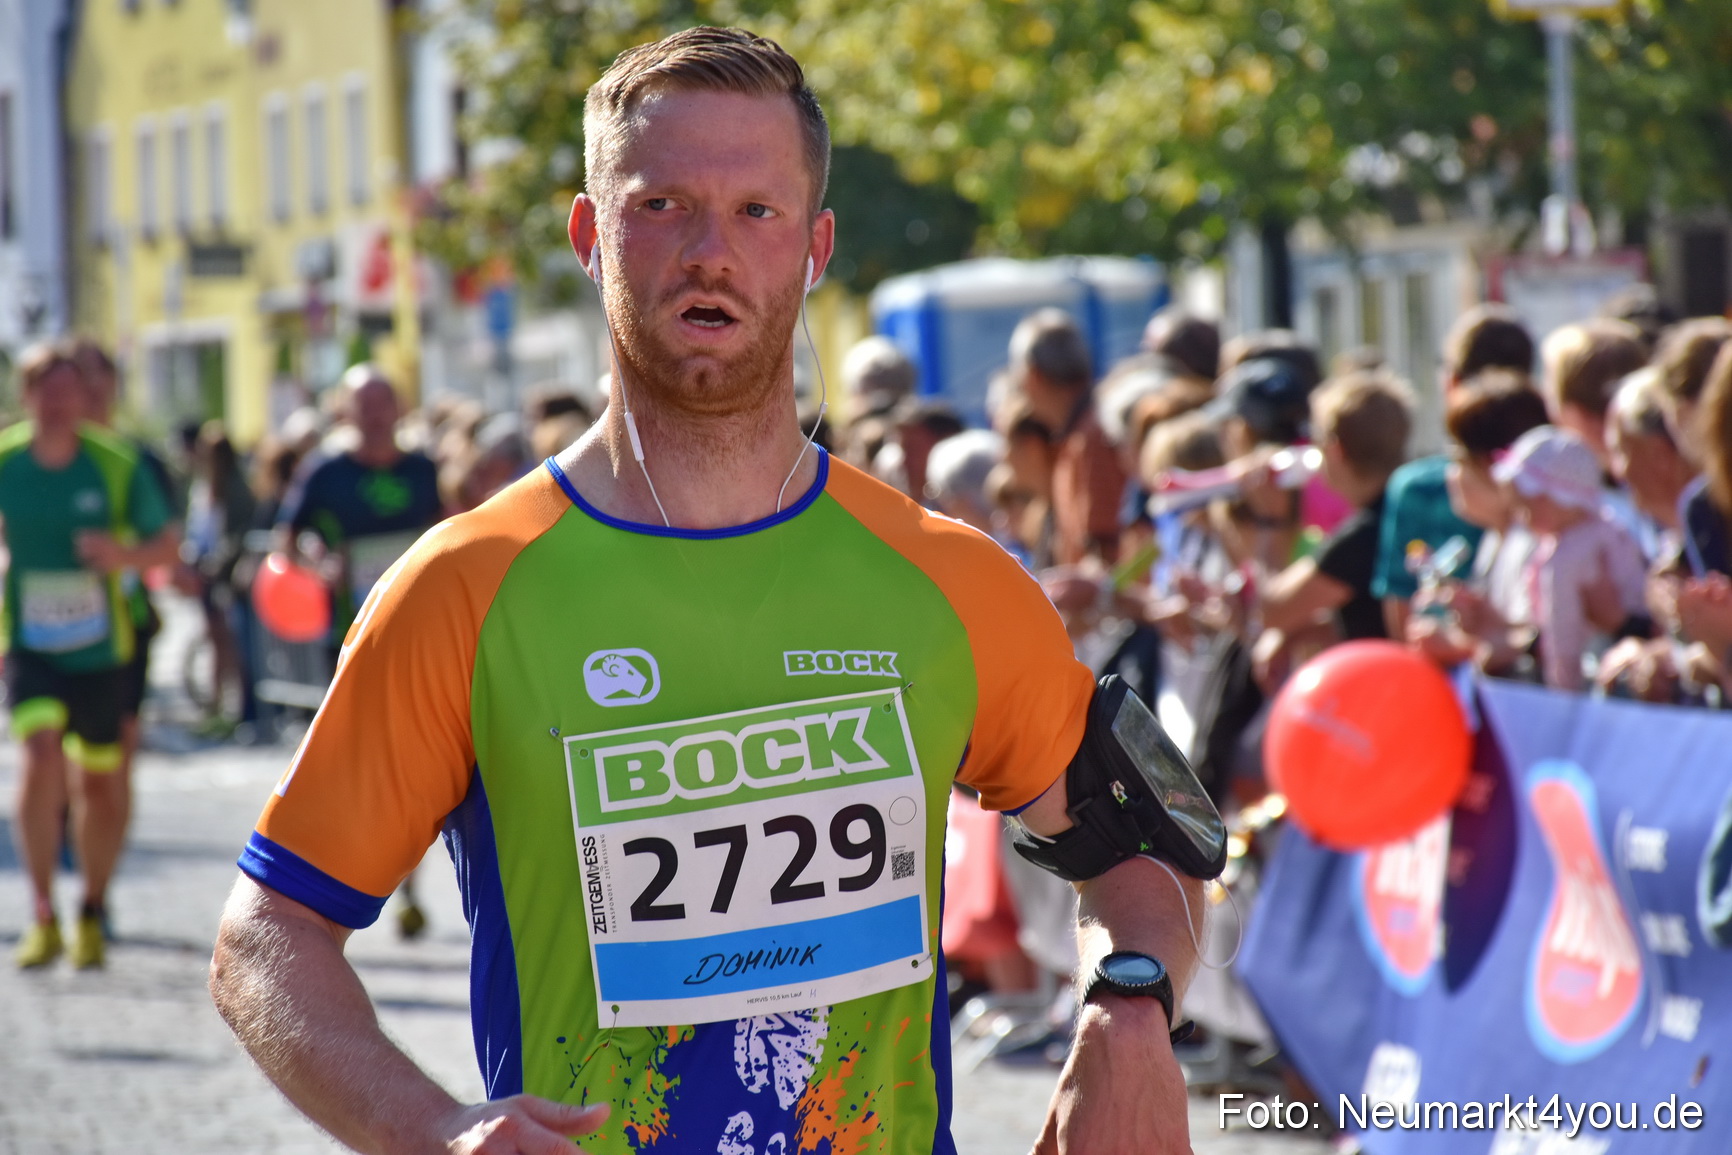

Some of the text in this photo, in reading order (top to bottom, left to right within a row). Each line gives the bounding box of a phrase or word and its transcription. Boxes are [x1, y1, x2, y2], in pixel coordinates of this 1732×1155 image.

[783, 650, 901, 678] BOCK
[593, 707, 890, 813] BOCK
[600, 834, 617, 933] TRANSPONDER ZEITMESSUNG
[623, 803, 887, 922] 2729
[747, 996, 769, 1004] HERVIS
